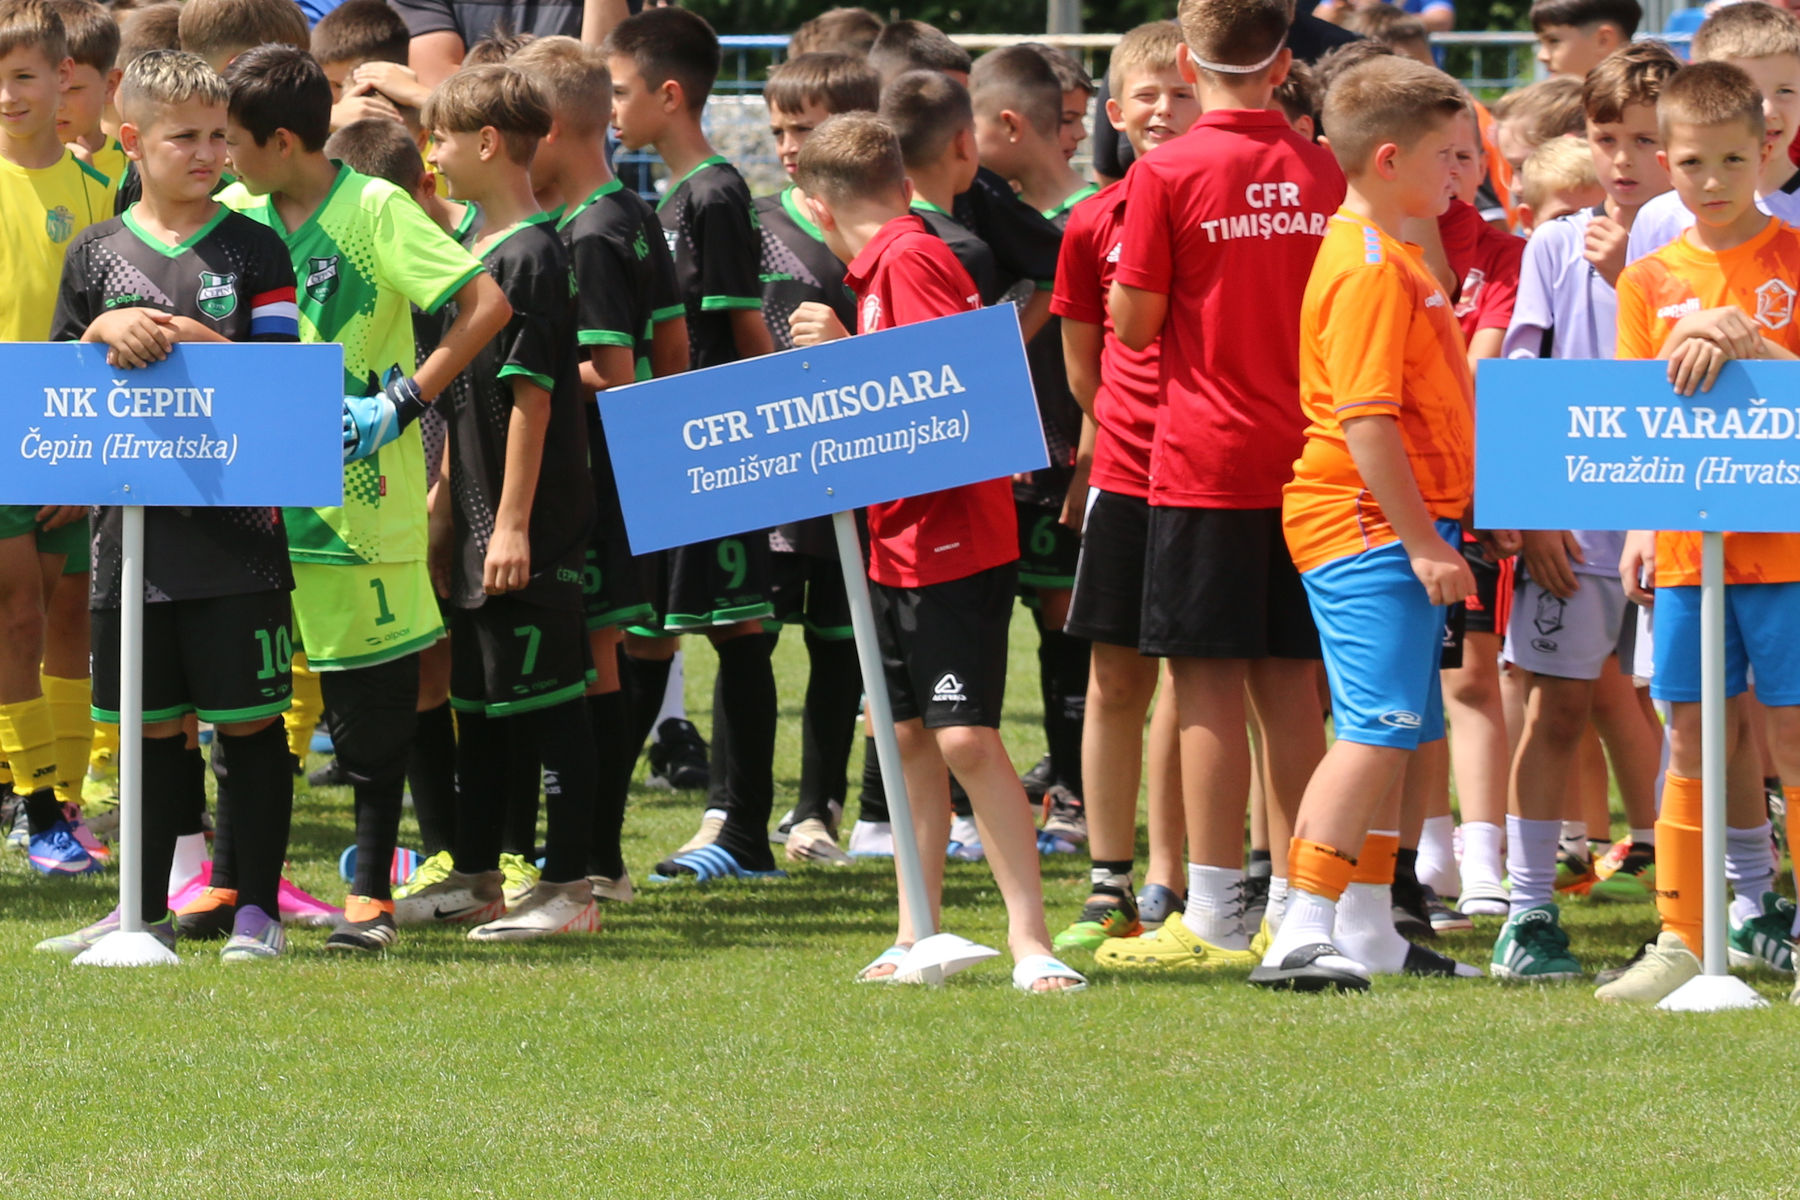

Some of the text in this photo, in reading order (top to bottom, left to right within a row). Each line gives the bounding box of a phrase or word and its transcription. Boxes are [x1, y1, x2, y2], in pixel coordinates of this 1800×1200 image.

[1245, 181, 1301, 209] CFR
[43, 379, 215, 418] NK ČEPIN
[682, 364, 966, 451] CFR TIMISOARA
[1567, 405, 1627, 439] NK
[20, 426, 238, 466] Čepin (Hrvatska)
[687, 409, 970, 495] Temišvar (Rumunjska)
[1565, 455, 1800, 492] Varaždin (Hrvats
[1031, 516, 1056, 556] 6
[717, 539, 748, 589] 9
[369, 577, 396, 627] 1
[254, 625, 292, 680] 10
[513, 625, 542, 676] 7
